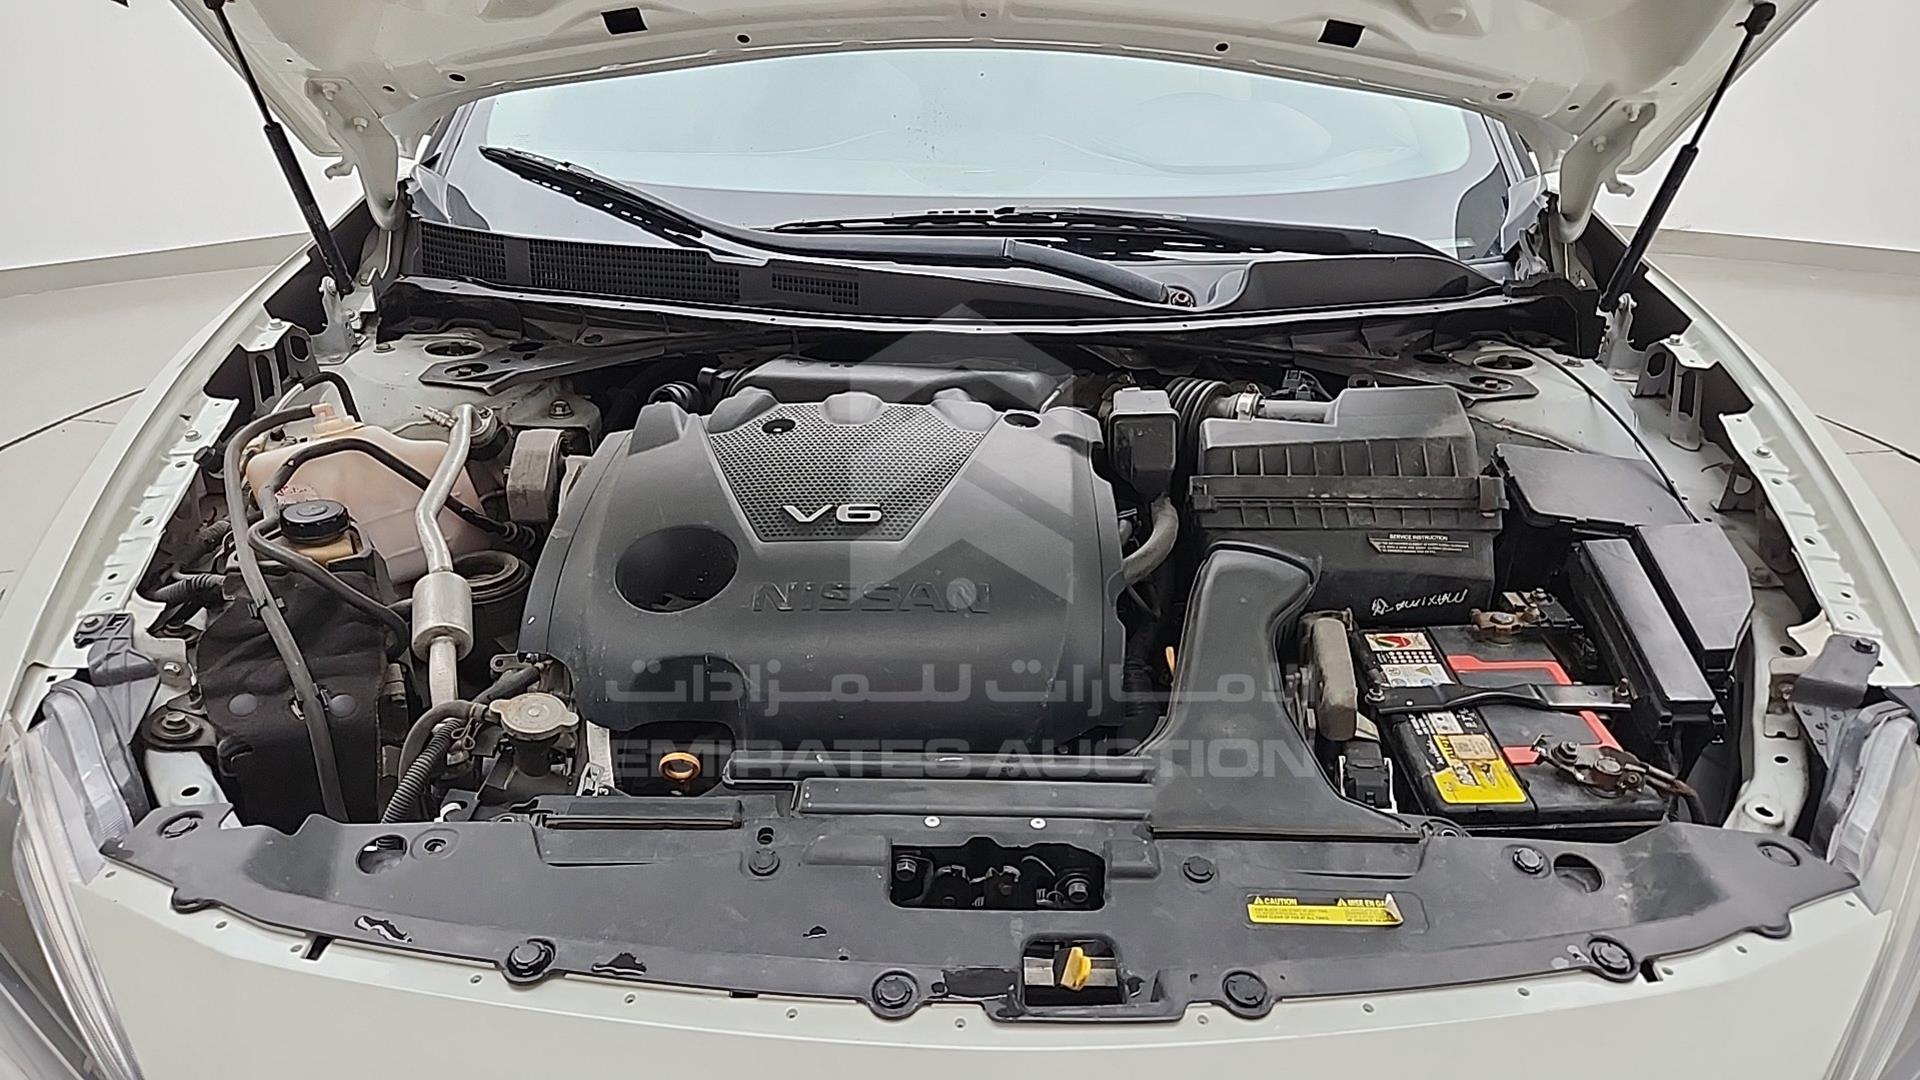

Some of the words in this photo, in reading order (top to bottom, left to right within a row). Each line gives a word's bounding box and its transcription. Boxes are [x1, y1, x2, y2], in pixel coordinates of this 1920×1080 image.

[782, 503, 884, 524] V6
[1389, 533, 1411, 541] SERVICE
[751, 581, 992, 614] NISSAN
[1264, 897, 1298, 906] CAUTION
